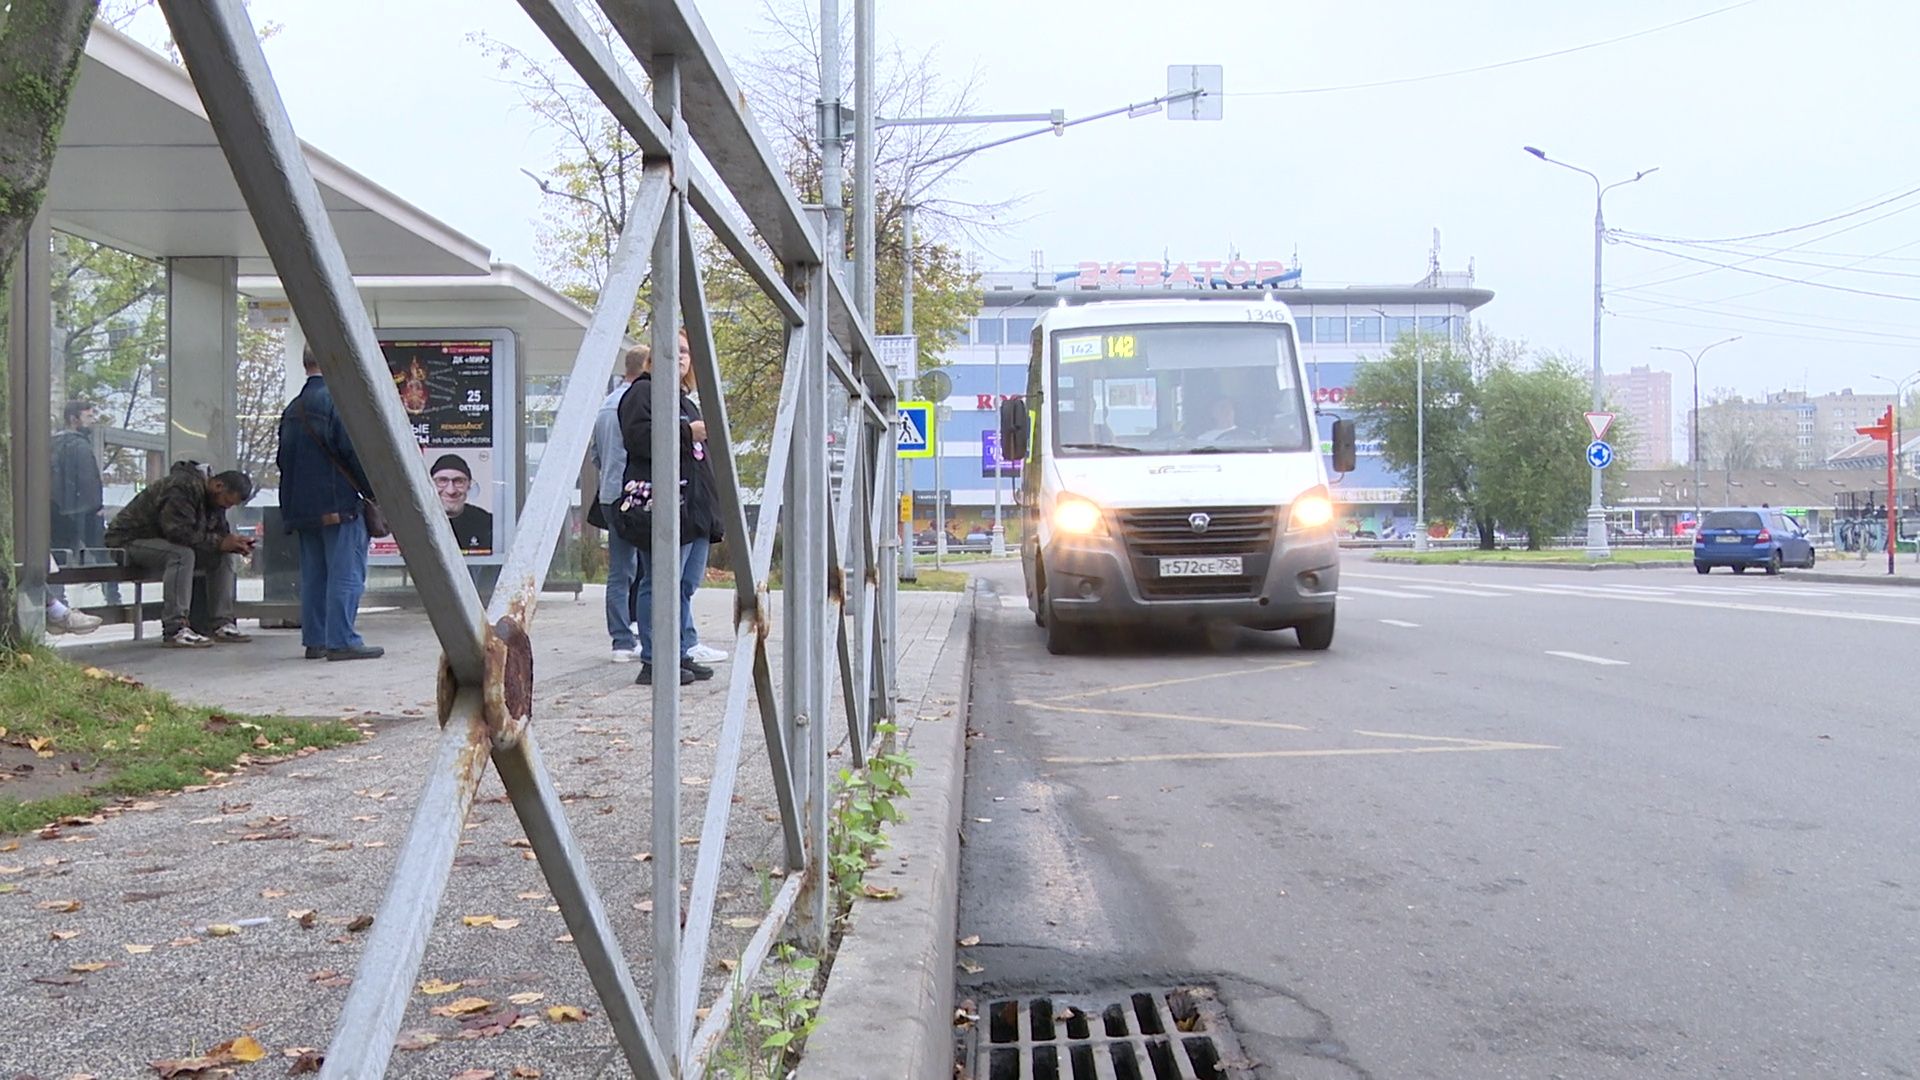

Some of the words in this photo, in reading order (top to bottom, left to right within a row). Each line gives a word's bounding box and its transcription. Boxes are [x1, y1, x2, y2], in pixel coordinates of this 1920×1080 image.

[1076, 260, 1286, 287] ЭКВАТОР
[1245, 308, 1284, 322] 1346
[1071, 344, 1093, 355] 142
[1107, 336, 1135, 358] 142
[452, 355, 464, 365] ДК
[467, 390, 481, 402] 25
[459, 404, 489, 412] ОКТЯБРЯ
[411, 424, 430, 434] ЫЕ
[1217, 559, 1239, 569] 750
